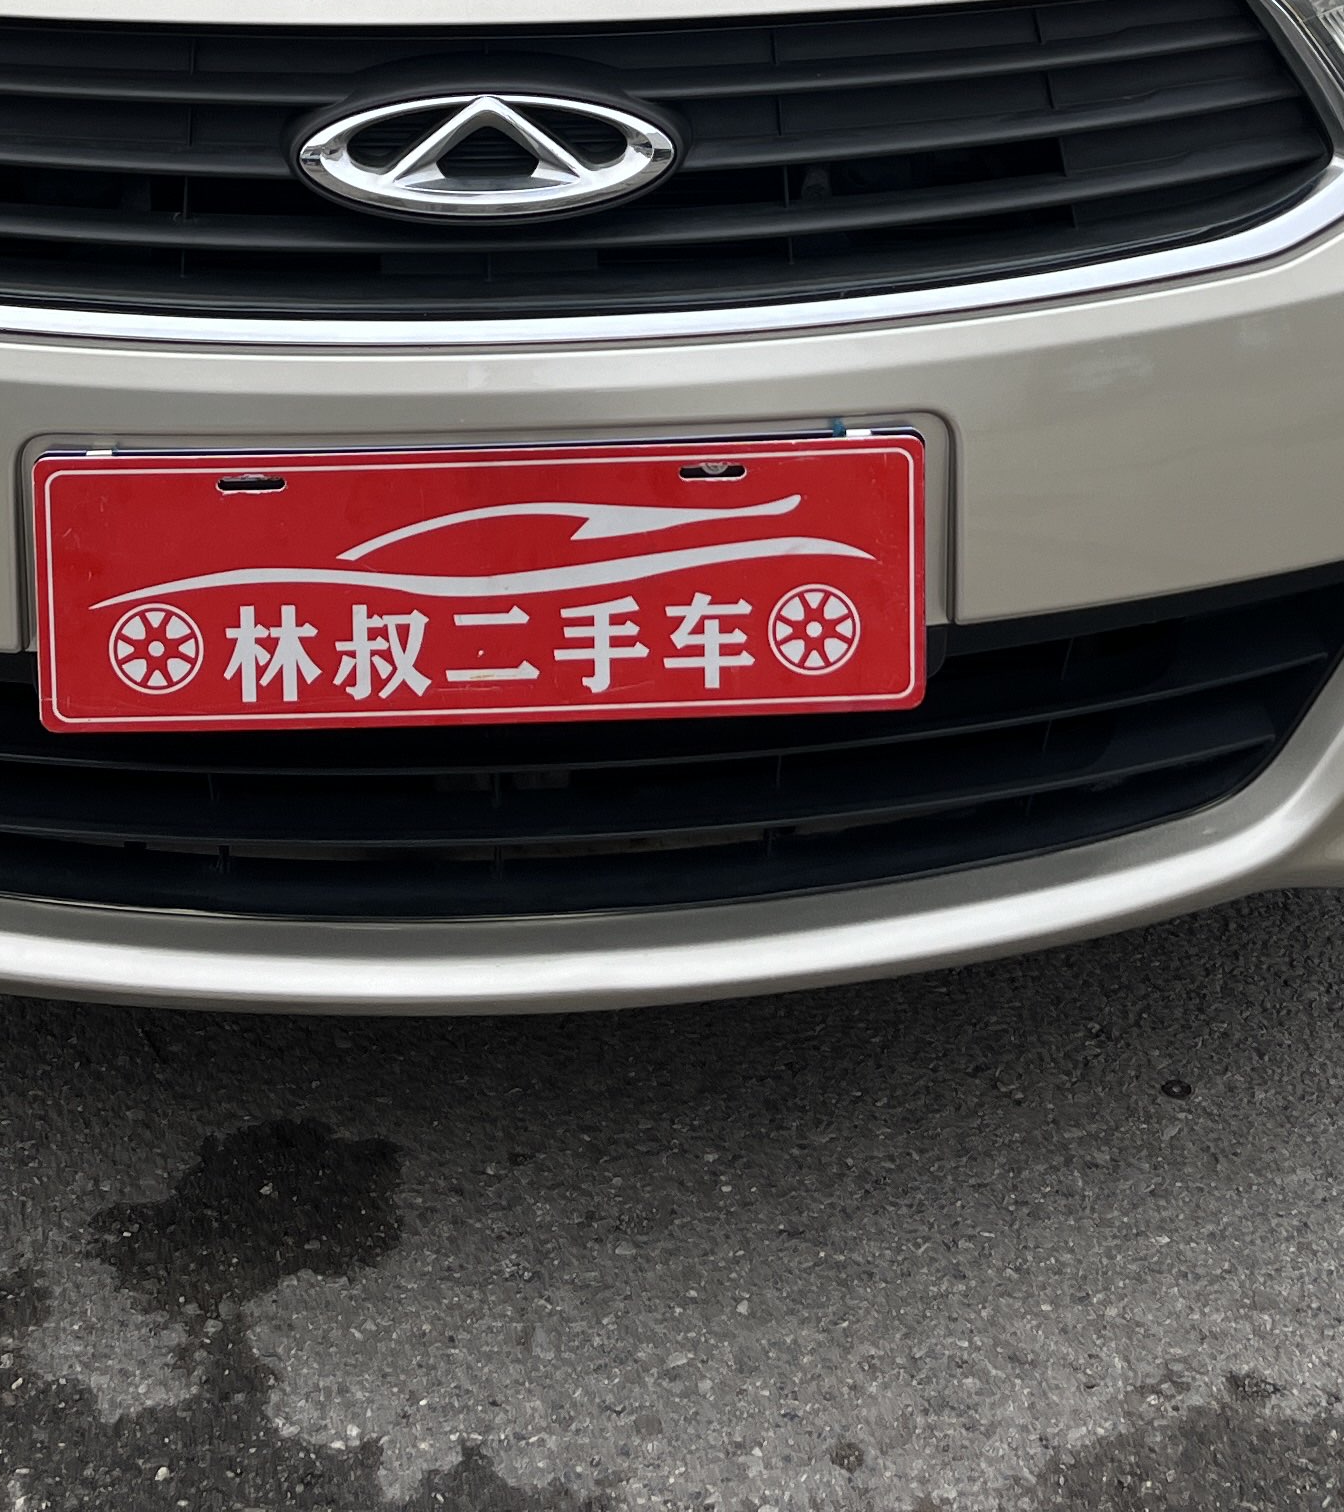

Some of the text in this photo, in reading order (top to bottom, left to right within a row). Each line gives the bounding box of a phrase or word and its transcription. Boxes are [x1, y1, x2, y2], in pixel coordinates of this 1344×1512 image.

[224, 592, 757, 702] 林叔二手车
